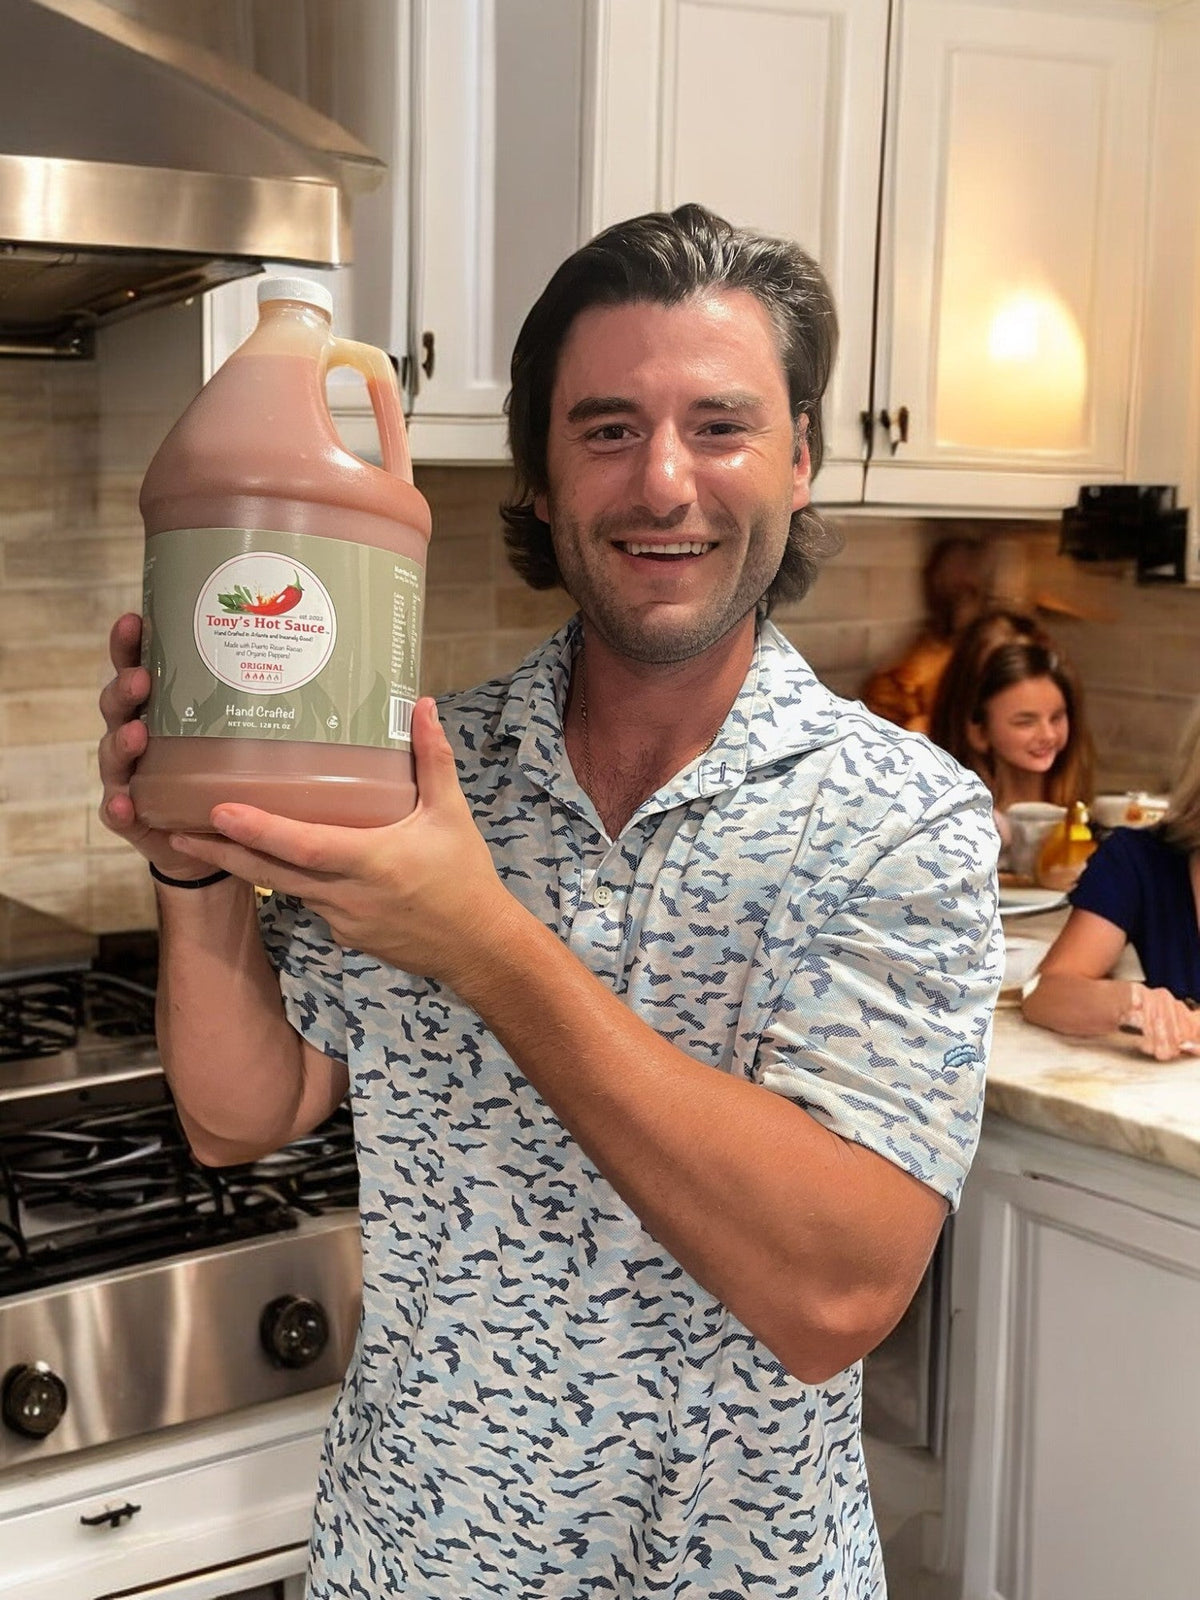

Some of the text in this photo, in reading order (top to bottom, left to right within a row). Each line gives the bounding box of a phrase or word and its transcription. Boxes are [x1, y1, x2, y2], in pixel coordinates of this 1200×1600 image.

[206, 615, 325, 634] Tony's Hot Sauce
[279, 634, 298, 642] Insanely
[251, 642, 268, 650] Puerto
[246, 649, 266, 658] Organic
[240, 662, 284, 671] ORIGINAL
[226, 704, 295, 719] Hand Crafted
